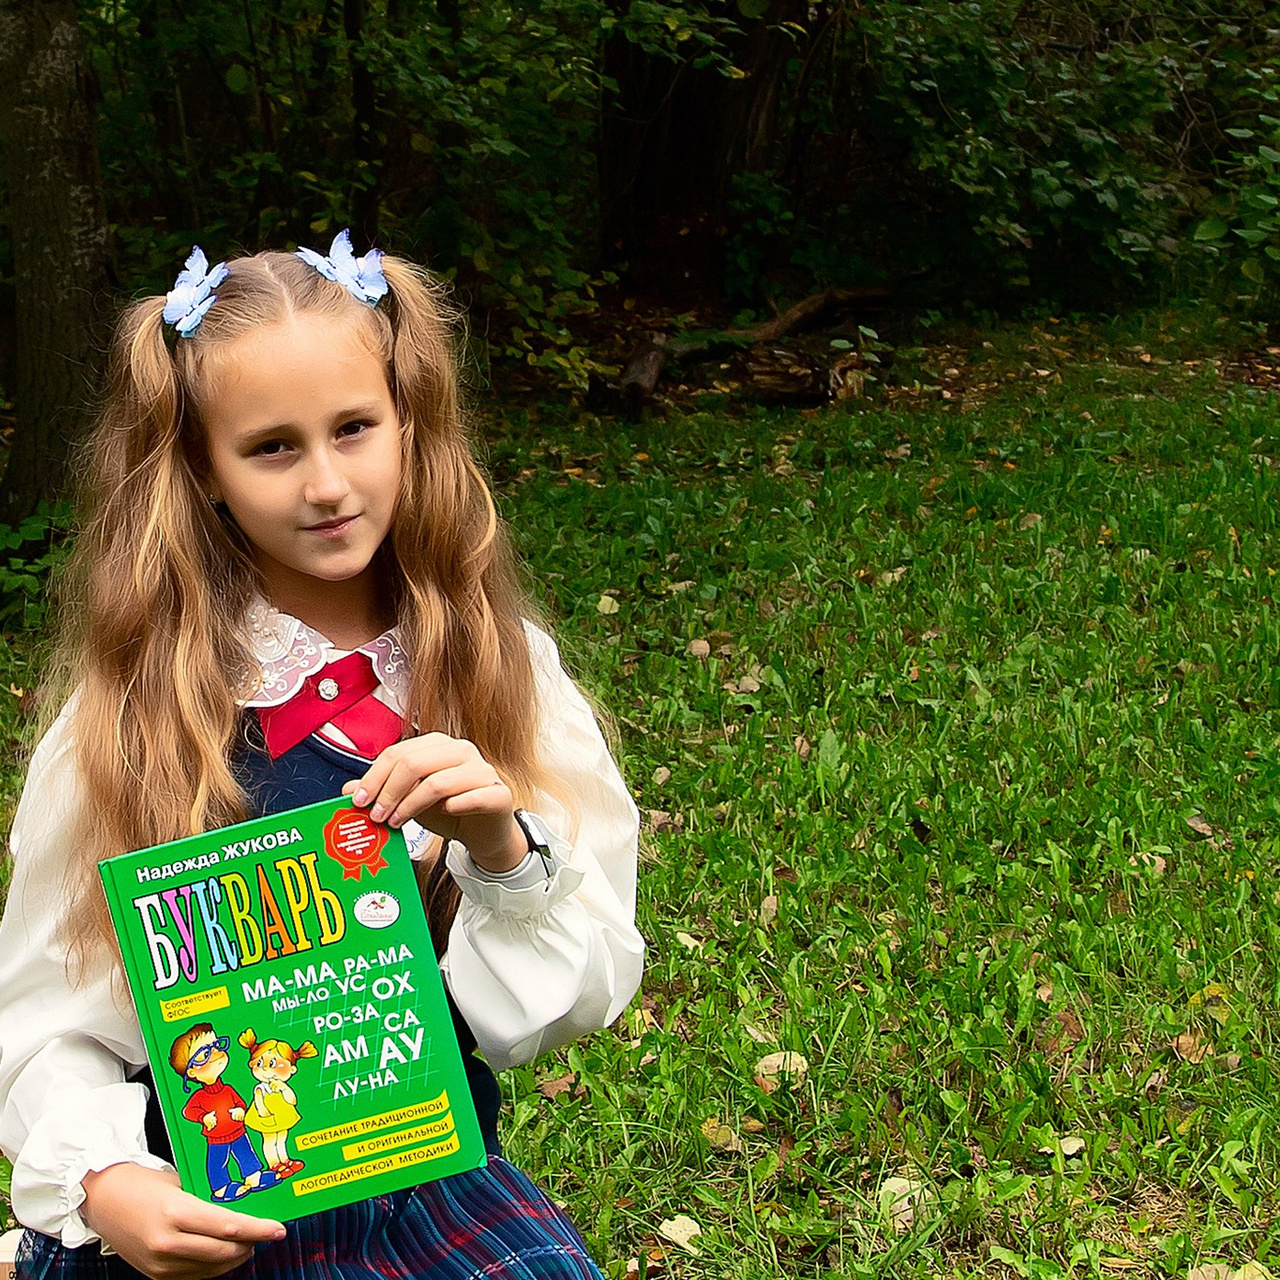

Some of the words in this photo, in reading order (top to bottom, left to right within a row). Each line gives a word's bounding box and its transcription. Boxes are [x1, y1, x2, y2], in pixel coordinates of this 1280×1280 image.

[136, 853, 220, 883] Надежда
[222, 828, 303, 861] ЖУКОВА
[132, 851, 347, 991] БУКВАРЬ
[240, 961, 339, 1003] МА-МА
[343, 943, 414, 975] РА-МА
[272, 987, 330, 1013] МЫ-ЛО
[334, 973, 367, 995] УС
[372, 970, 416, 1000] ОХ
[313, 1002, 380, 1034] РО-ЗА
[383, 1008, 421, 1033] СА
[324, 1034, 370, 1068] АМ
[378, 1027, 425, 1070] АУ
[333, 1067, 399, 1100] ЛУ-НА
[301, 1123, 359, 1147] СОЧЕТАНИЕ
[361, 1100, 444, 1131] ТРАДИЦИОННОЙ
[368, 1122, 449, 1151] ОРИГИНАЛЬНОЙ
[300, 1158, 394, 1191] ЛОГОПЕДИЧЕСКОЙ
[399, 1142, 454, 1164] МЕТОДИКИ
